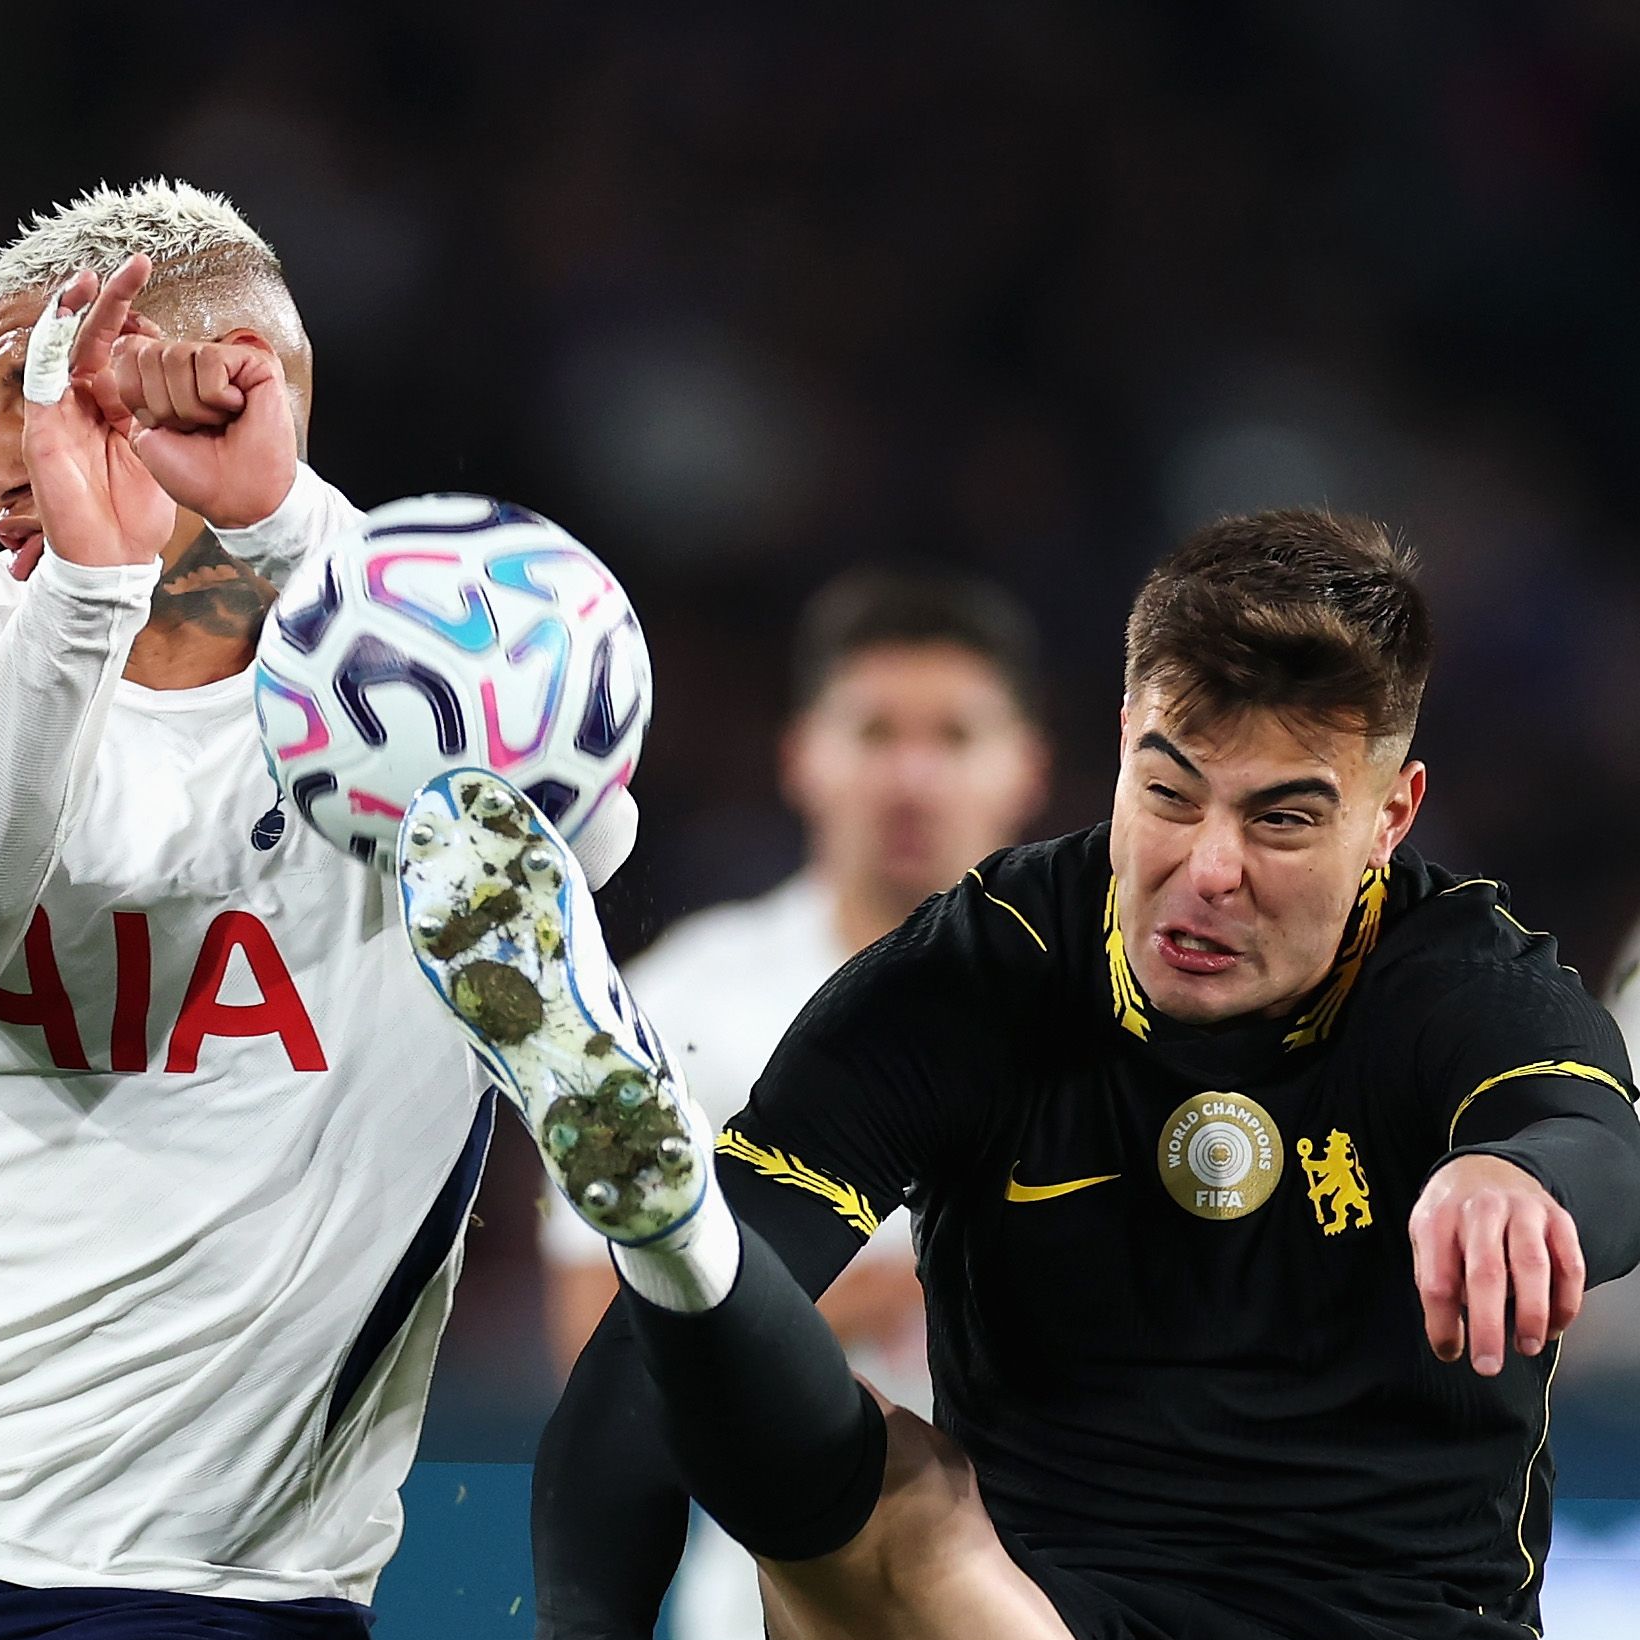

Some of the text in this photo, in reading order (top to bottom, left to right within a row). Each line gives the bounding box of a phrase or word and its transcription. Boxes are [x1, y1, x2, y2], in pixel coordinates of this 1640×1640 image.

[1168, 1102, 1272, 1170] WORLD CHAMPIONS
[1196, 1190, 1245, 1208] FIFA
